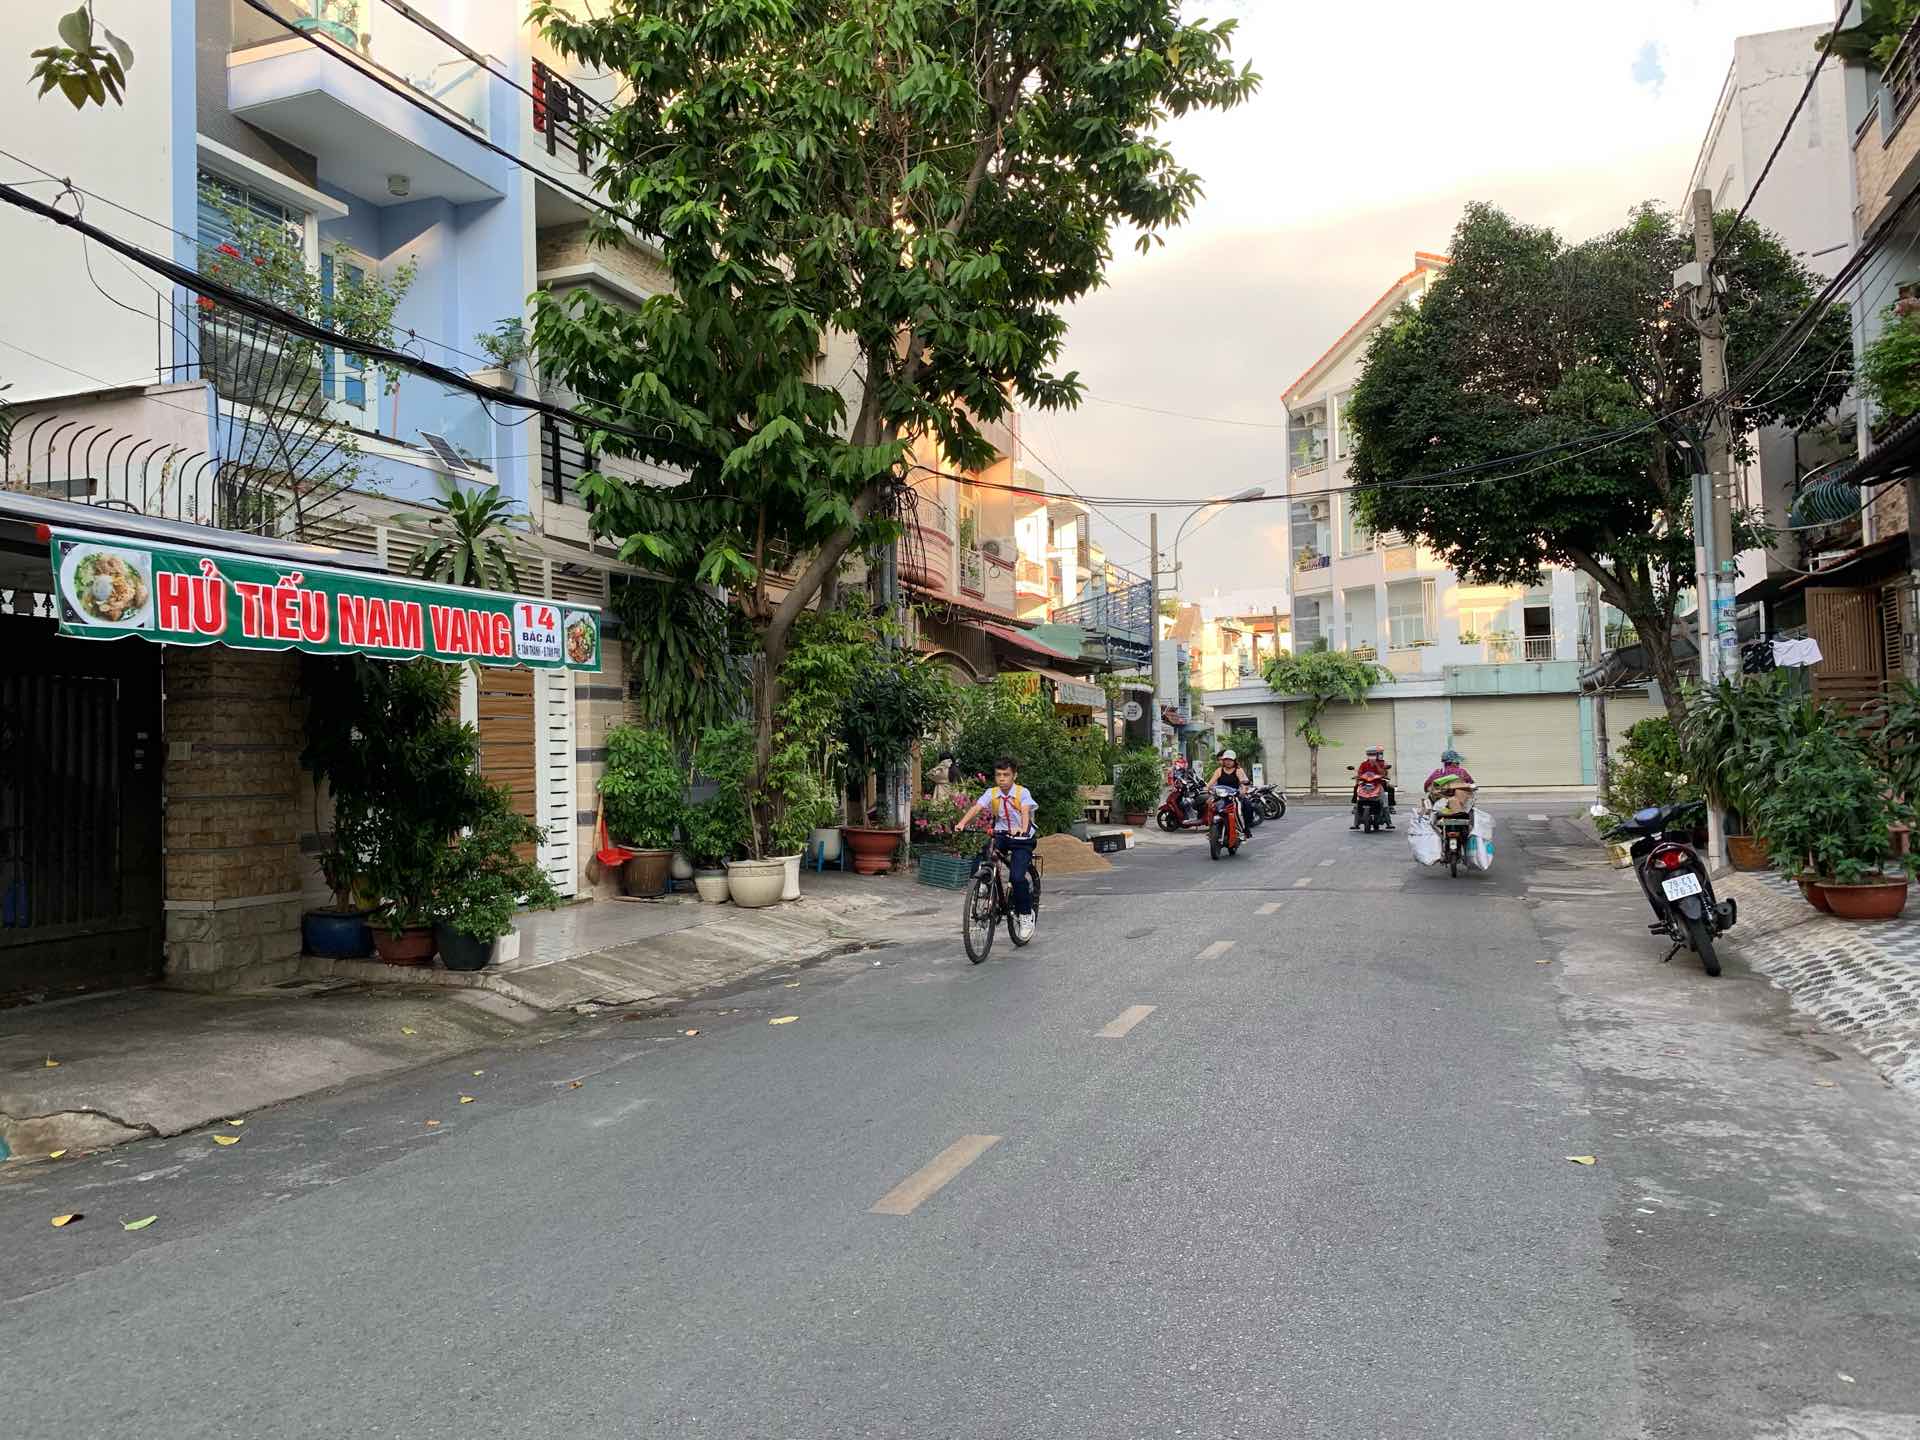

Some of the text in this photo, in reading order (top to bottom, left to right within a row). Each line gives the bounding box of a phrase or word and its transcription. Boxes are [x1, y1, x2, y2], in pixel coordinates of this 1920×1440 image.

[156, 558, 513, 657] HỦ TIẾU NAM VANG
[520, 604, 555, 630] 14
